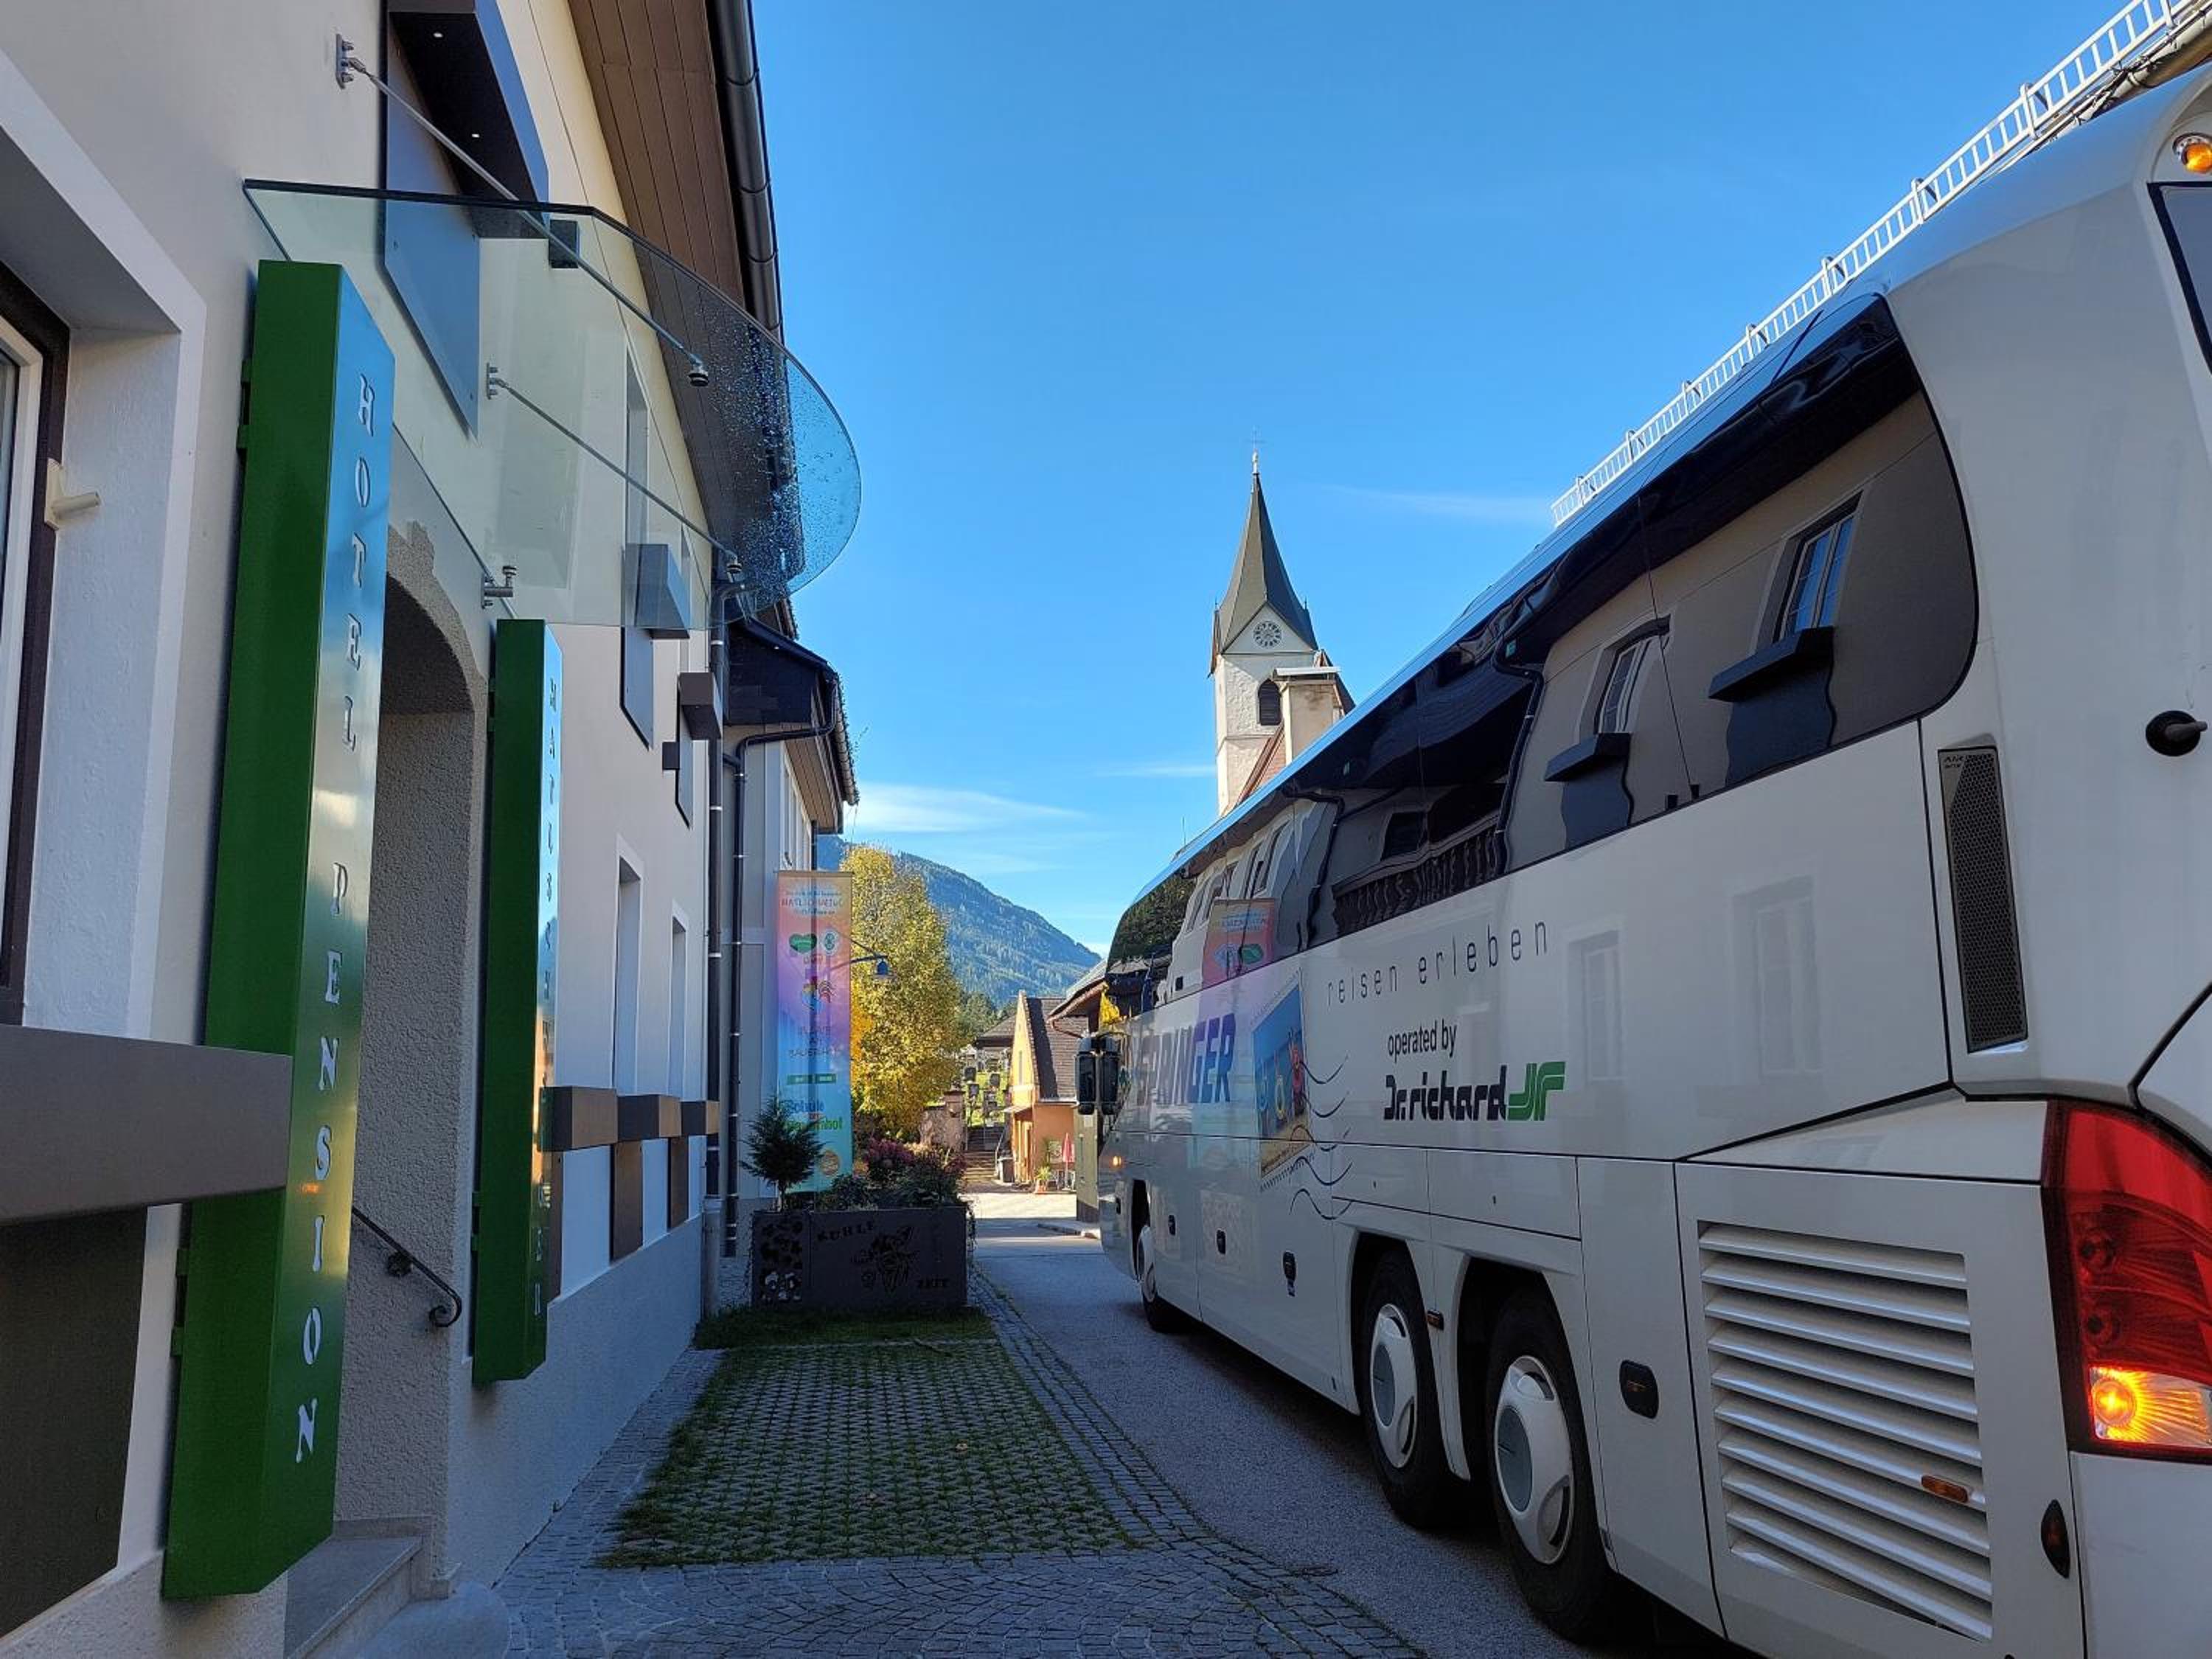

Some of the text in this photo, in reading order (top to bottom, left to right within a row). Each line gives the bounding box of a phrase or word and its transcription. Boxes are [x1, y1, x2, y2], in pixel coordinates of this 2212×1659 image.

[296, 374, 375, 1463] HOTEL PENSION
[1327, 964, 1398, 1007] reisen
[1418, 921, 1548, 984] erleben
[1387, 1019, 1457, 1063] operated by
